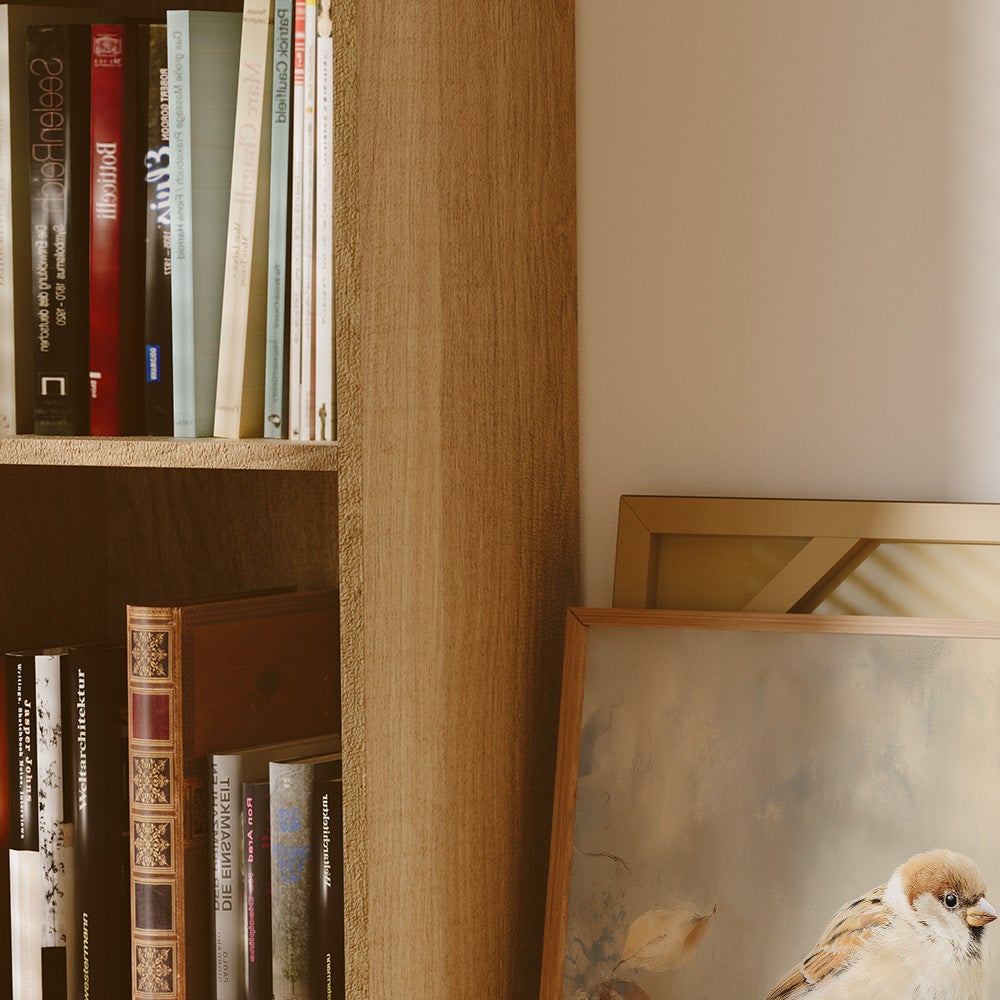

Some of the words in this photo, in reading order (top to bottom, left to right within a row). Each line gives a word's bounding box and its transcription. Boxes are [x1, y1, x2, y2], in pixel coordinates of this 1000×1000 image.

[23, 699, 33, 751] Jasper
[77, 668, 87, 811] Weltarchitektur
[24, 757, 33, 802] Johns
